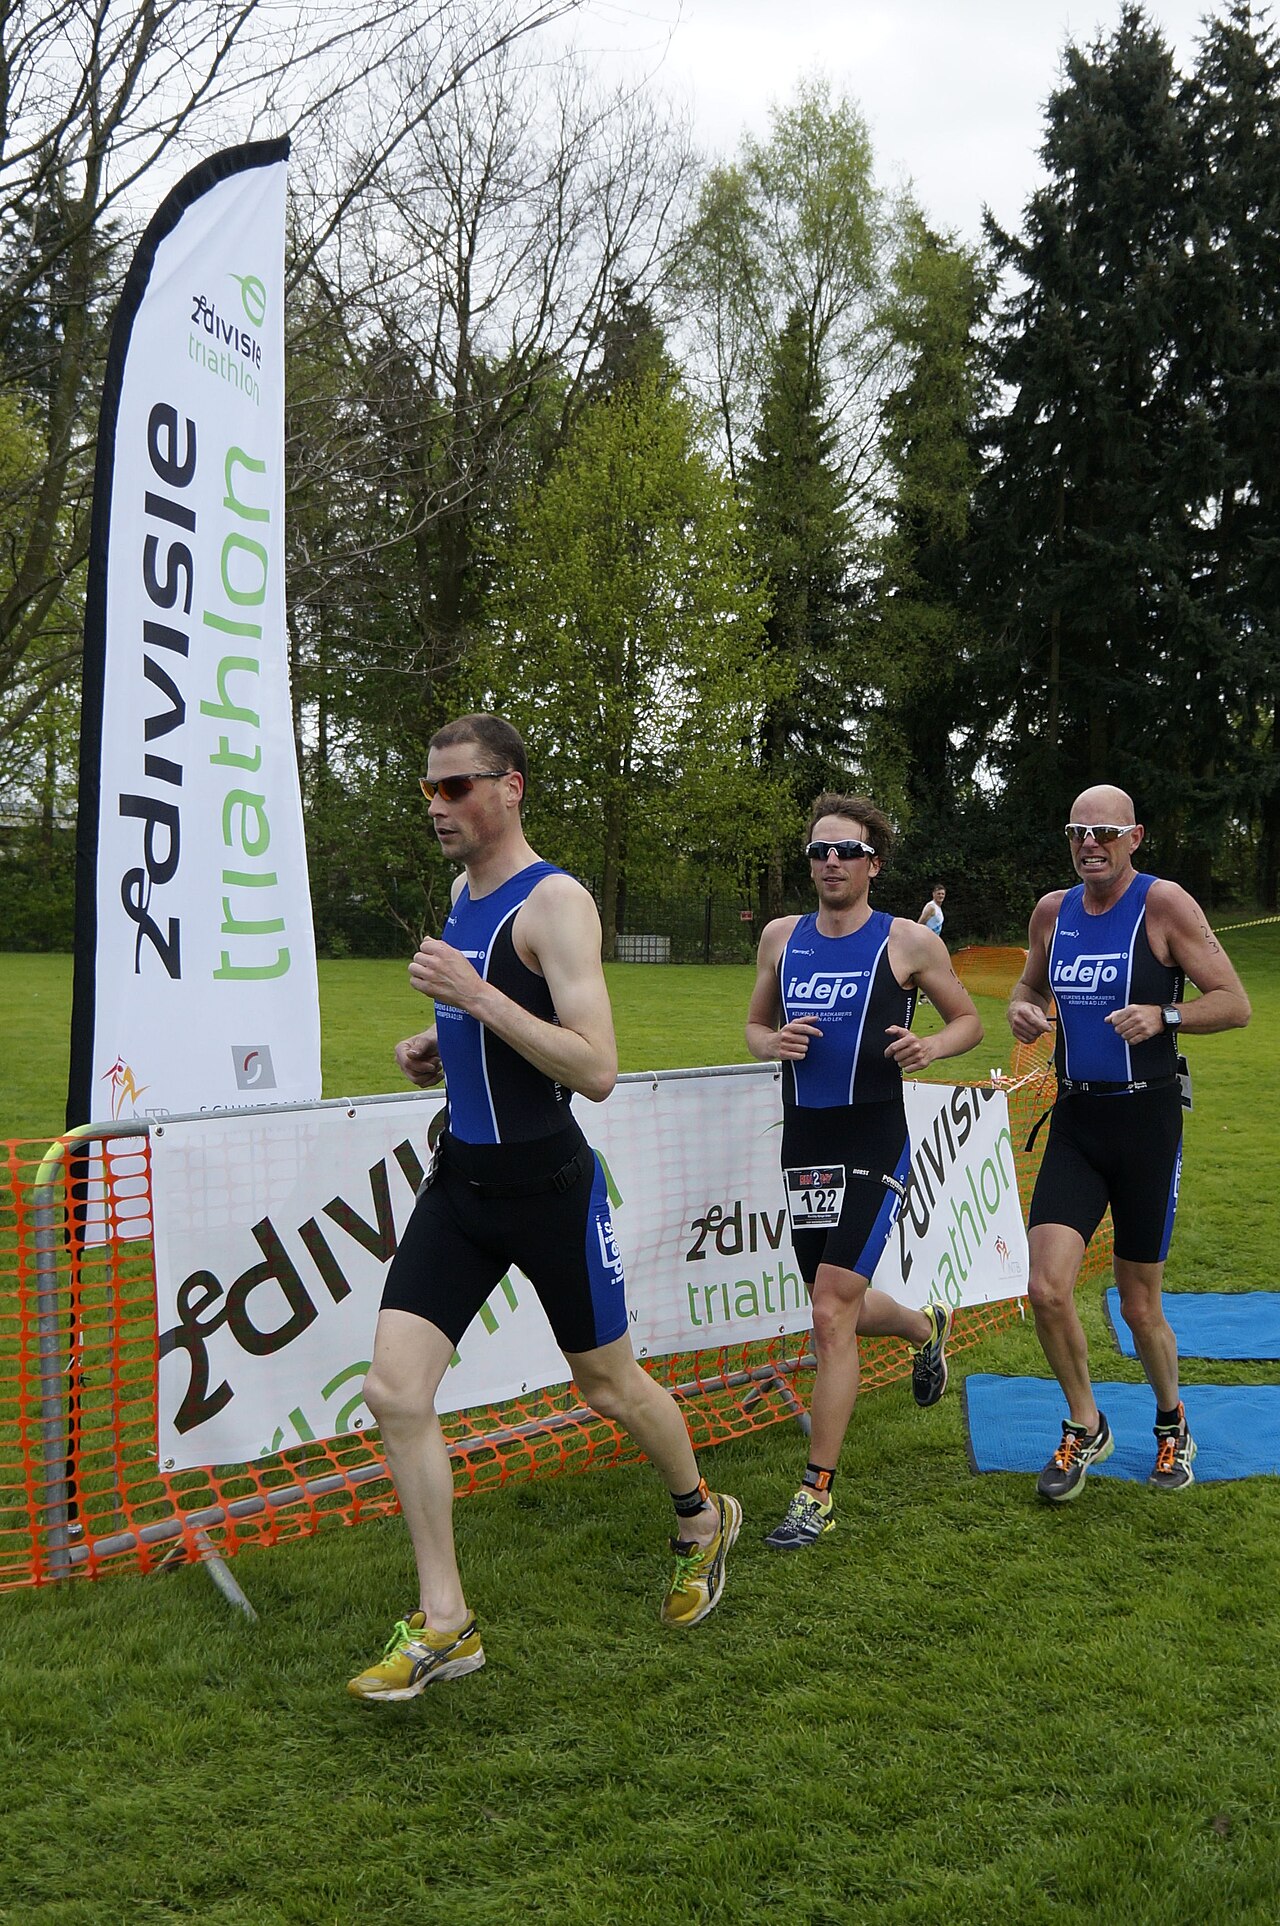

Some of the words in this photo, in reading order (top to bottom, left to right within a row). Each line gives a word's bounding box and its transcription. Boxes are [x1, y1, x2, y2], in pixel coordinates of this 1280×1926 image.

[188, 332, 261, 406] triathlon
[200, 445, 291, 982] triathlon
[787, 972, 861, 1008] idejo
[1054, 955, 1121, 992] idejo
[801, 1190, 837, 1213] 122
